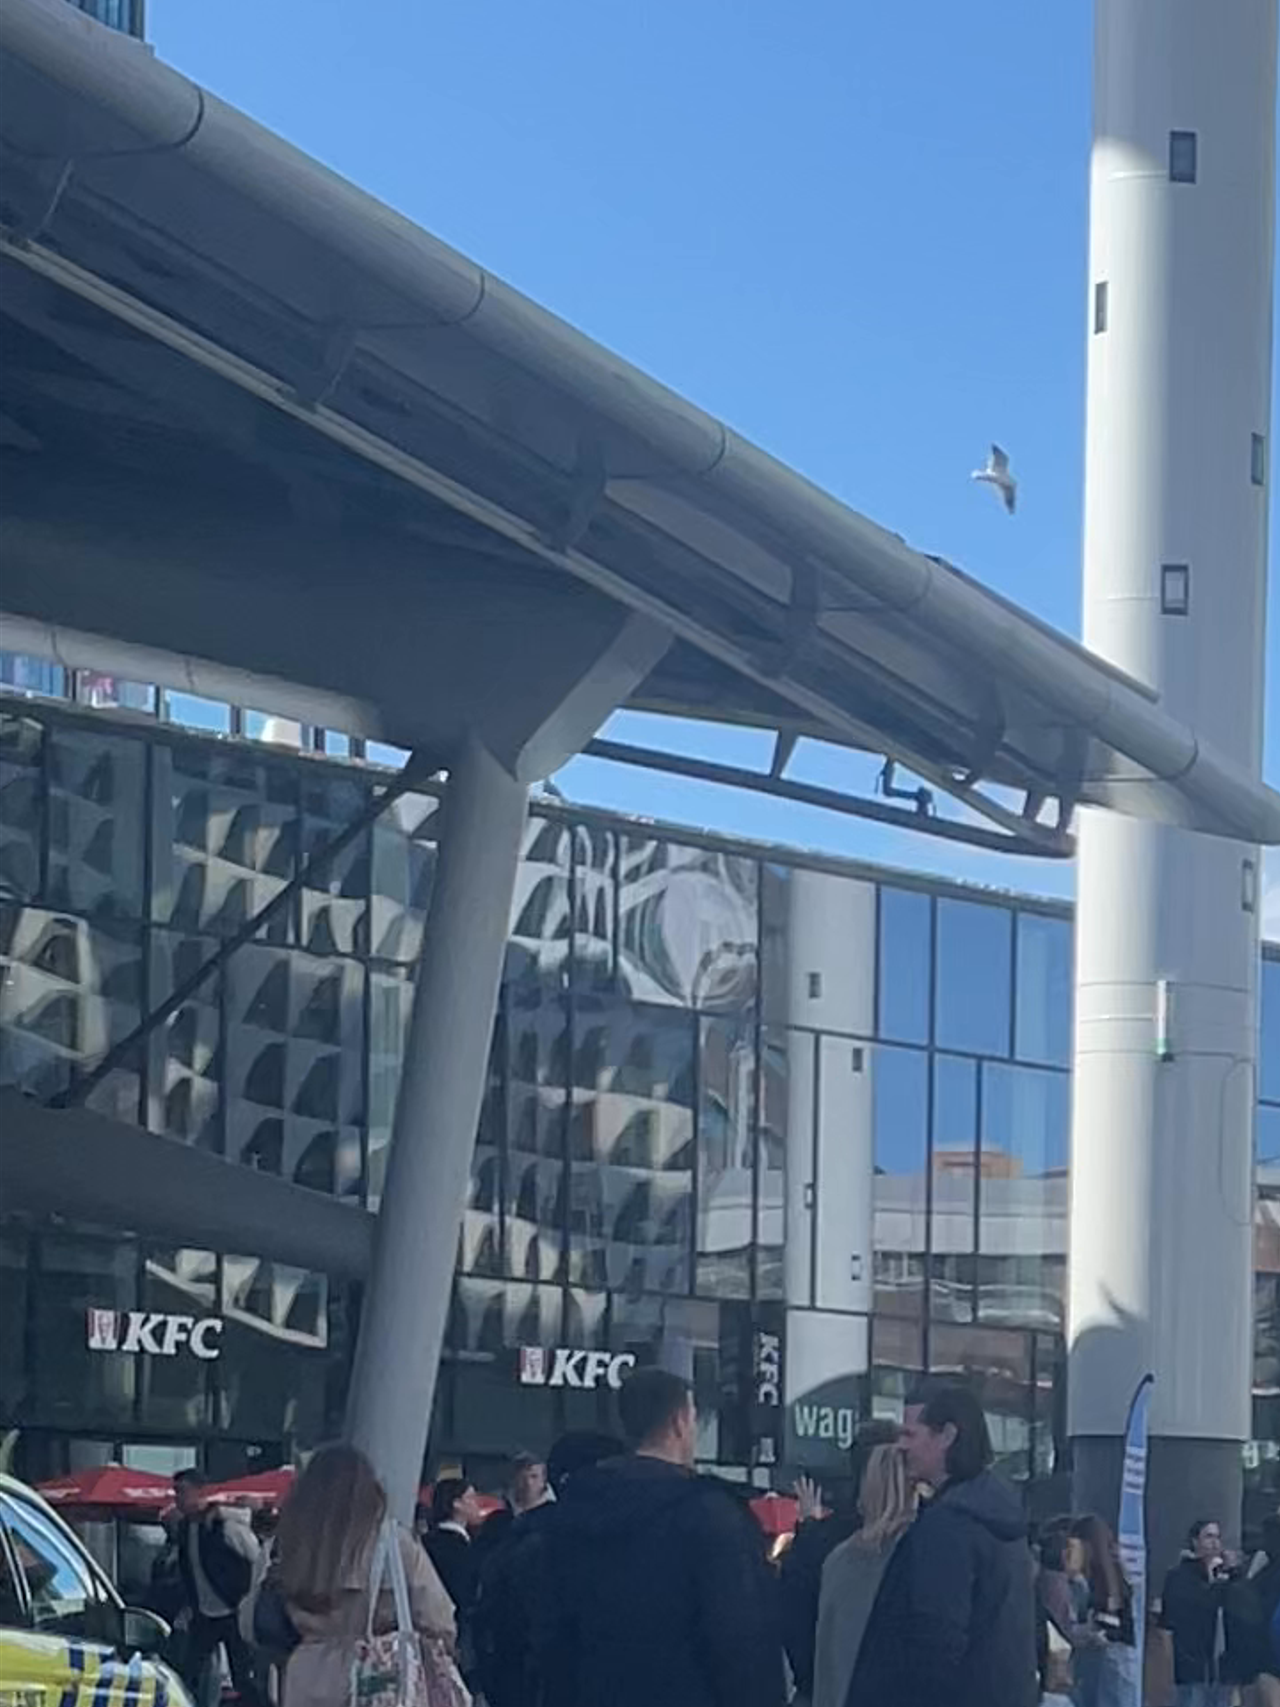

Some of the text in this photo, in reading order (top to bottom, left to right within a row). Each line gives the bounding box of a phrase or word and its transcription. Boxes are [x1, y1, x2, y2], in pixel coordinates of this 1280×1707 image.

[121, 1311, 223, 1359] KFC
[548, 1348, 635, 1390] KFC
[758, 1331, 779, 1406] KFC
[794, 1400, 860, 1450] wag
